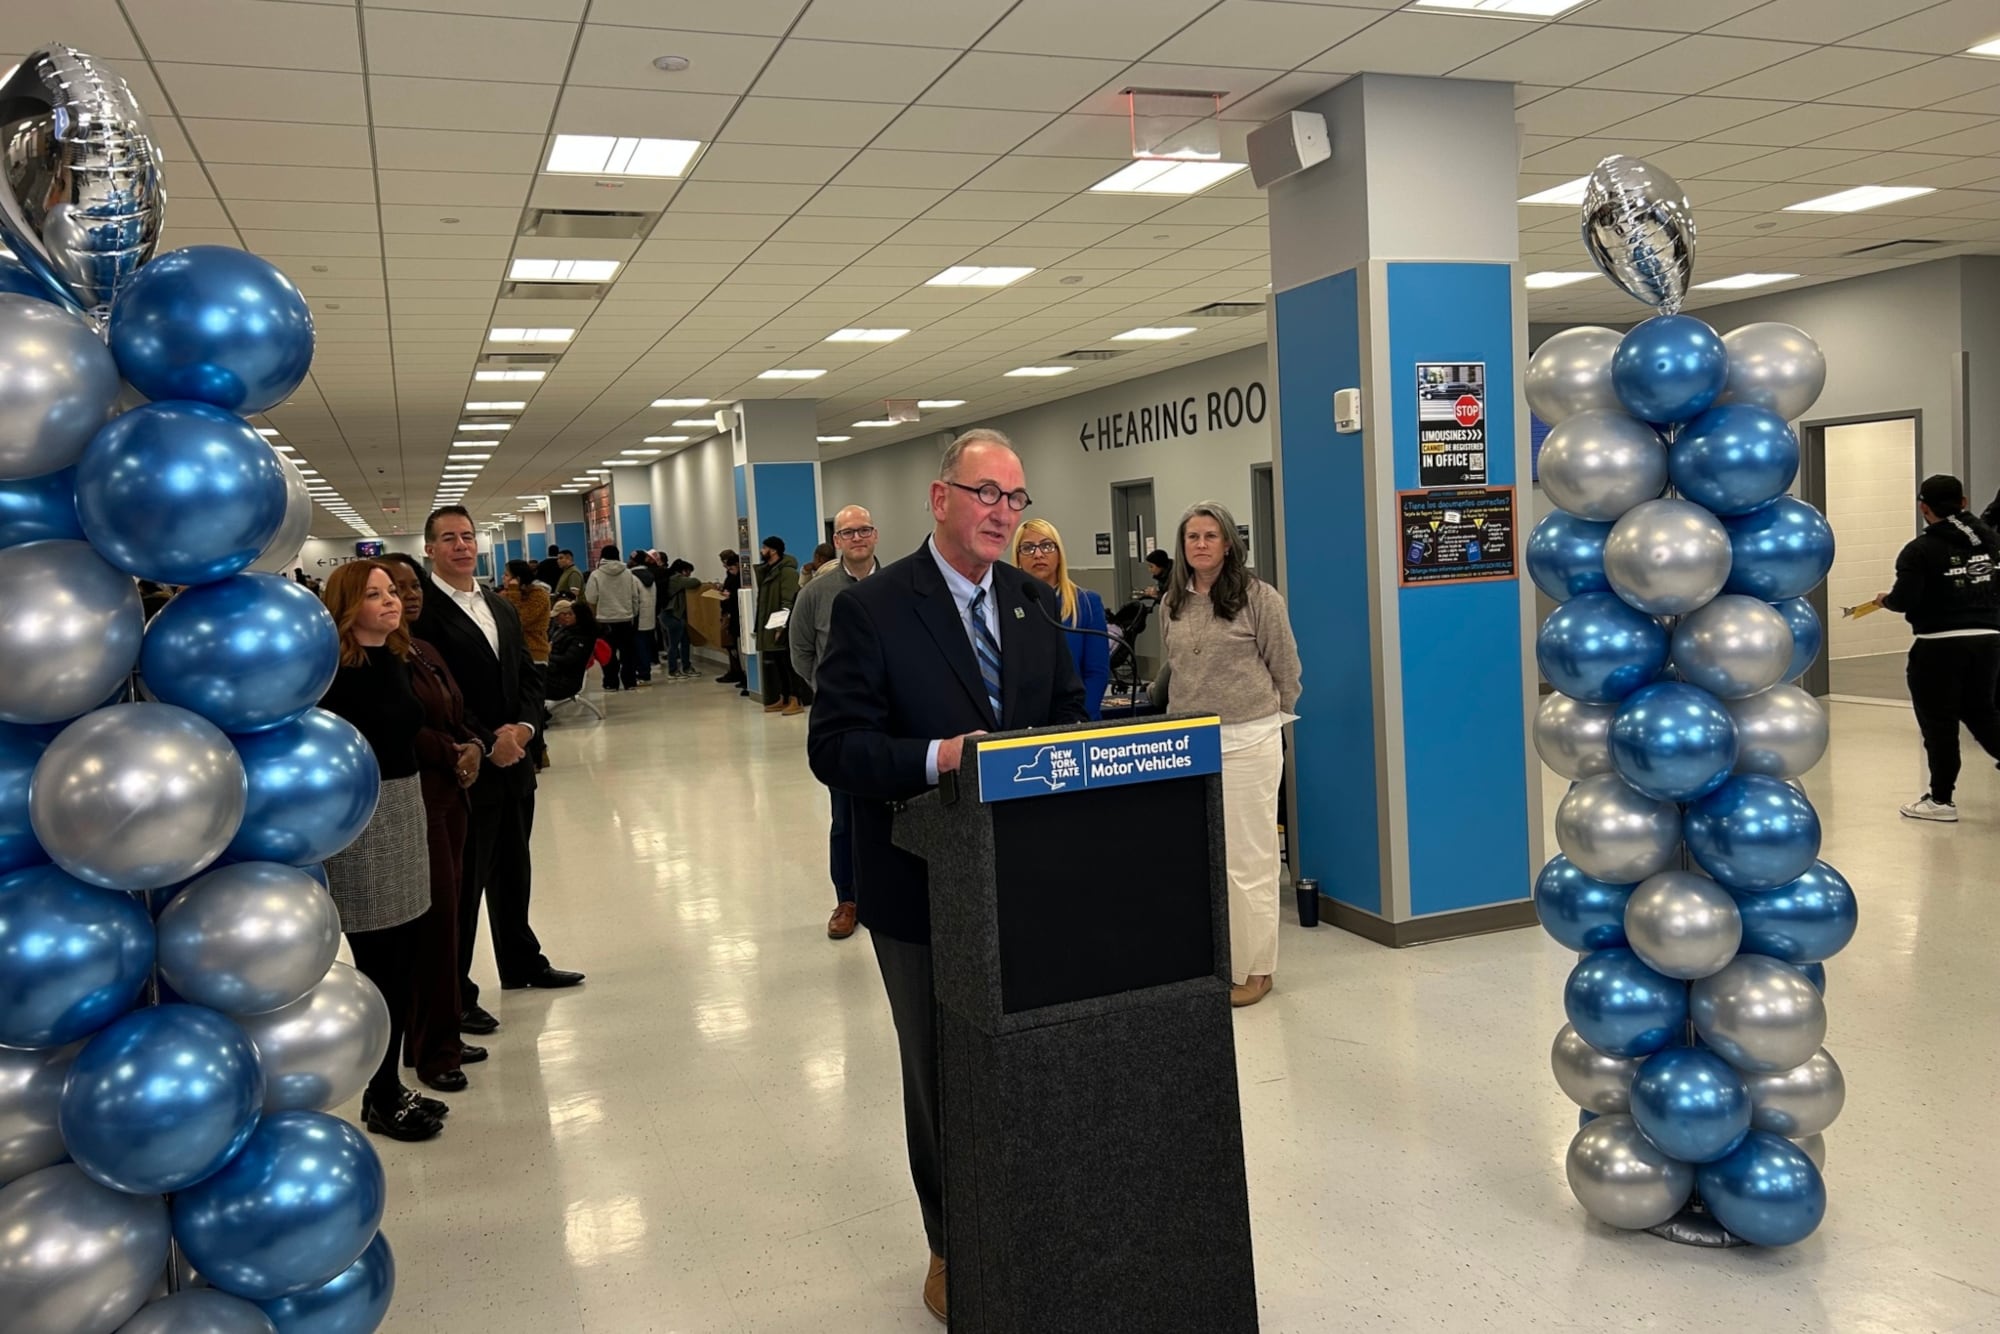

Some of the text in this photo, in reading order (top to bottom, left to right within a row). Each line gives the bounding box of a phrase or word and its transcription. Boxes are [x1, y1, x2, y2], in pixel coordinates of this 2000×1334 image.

[1456, 405, 1479, 416] STOP
[1097, 382, 1266, 451] HEARING ROO
[1422, 429, 1467, 441] LIMOUSINES
[1423, 443, 1484, 452] CANNOT BE REGISTERED
[1423, 453, 1468, 468] IN OFFICE
[1090, 735, 1190, 762] Department of
[1050, 750, 1072, 760] NEW
[1051, 759, 1076, 769] YORK
[1091, 754, 1192, 778] Motor Vehicles
[1051, 767, 1080, 778] STATE
